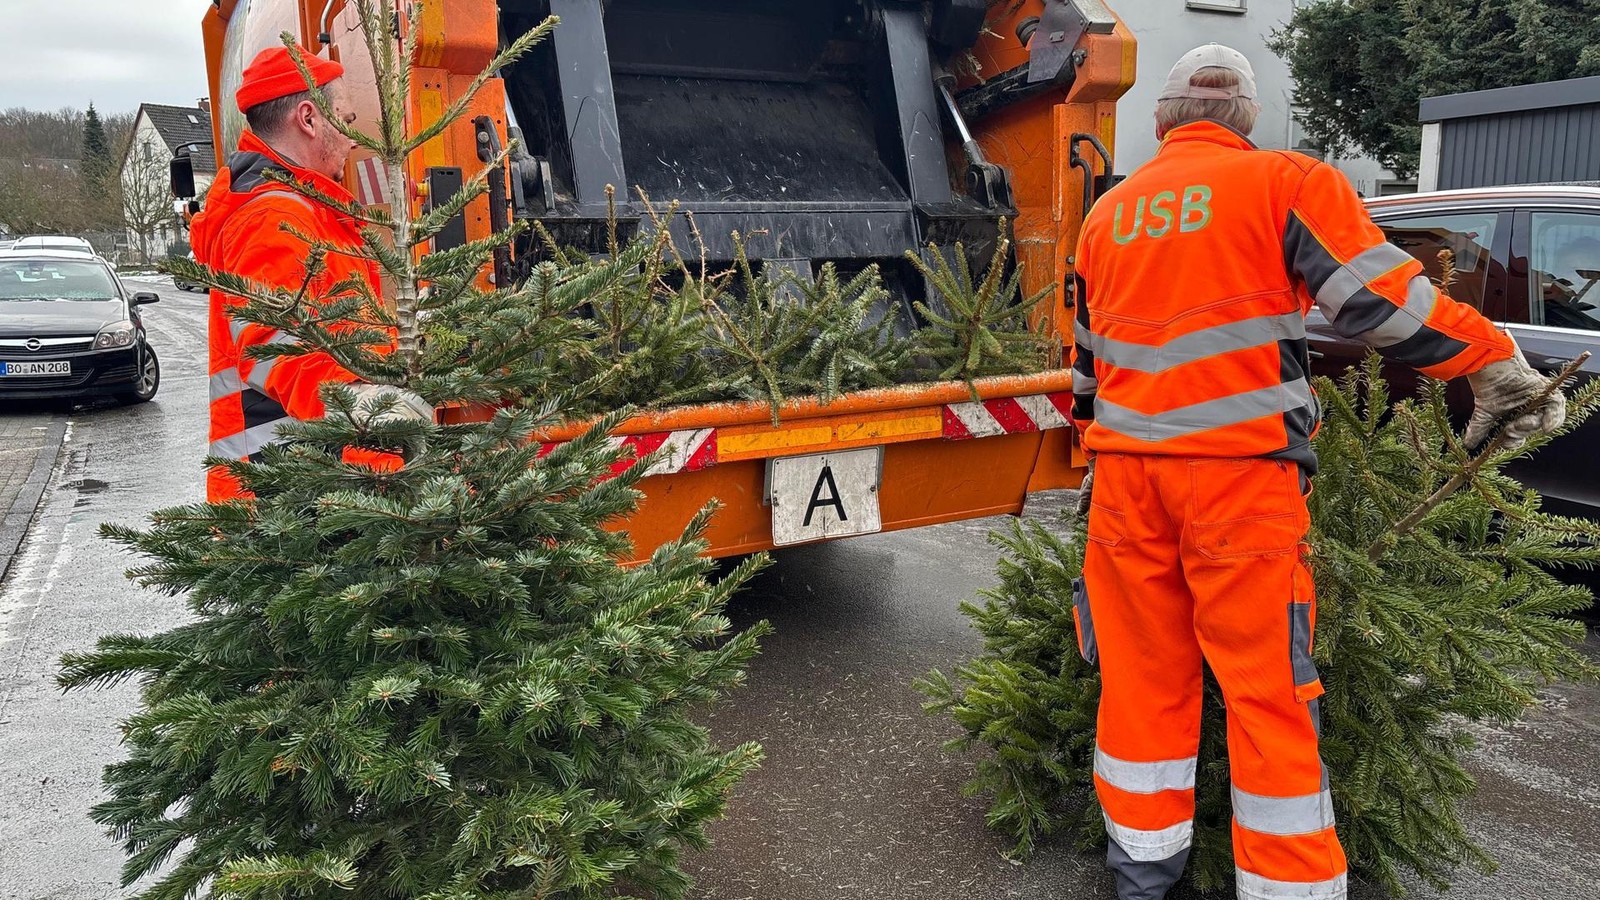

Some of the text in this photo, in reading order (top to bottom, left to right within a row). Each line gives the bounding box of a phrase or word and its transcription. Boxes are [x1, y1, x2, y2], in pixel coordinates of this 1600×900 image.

[1112, 184, 1213, 245] USB
[7, 363, 22, 374] BO
[30, 363, 46, 374] AN
[47, 362, 69, 373] 208
[803, 465, 848, 527] A
